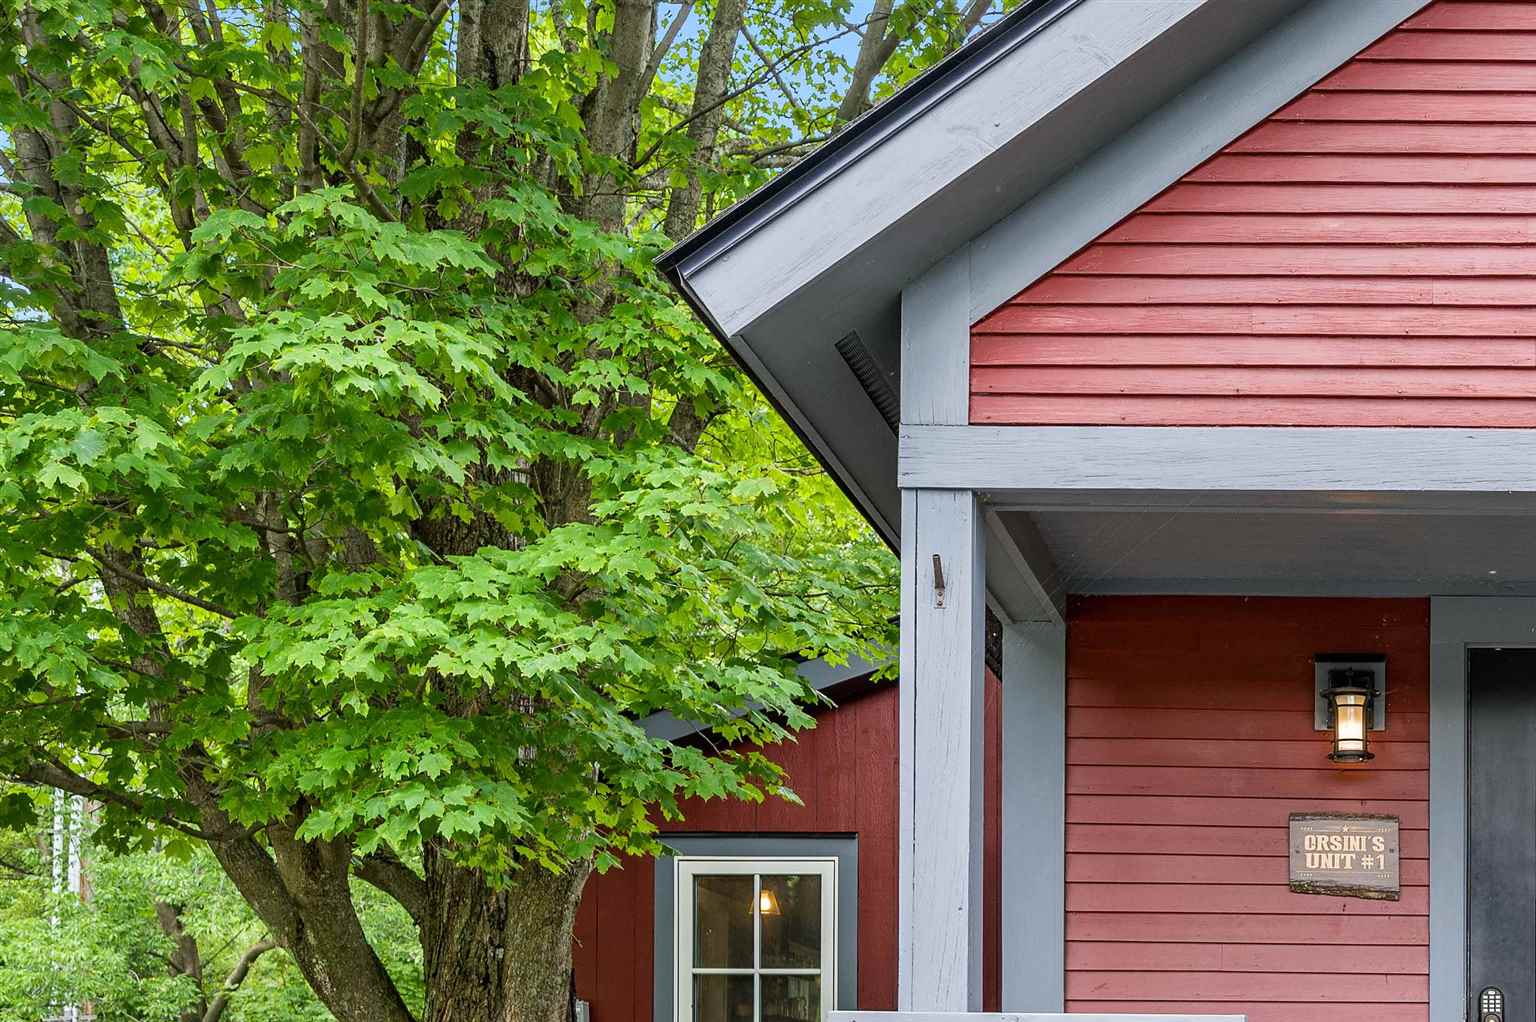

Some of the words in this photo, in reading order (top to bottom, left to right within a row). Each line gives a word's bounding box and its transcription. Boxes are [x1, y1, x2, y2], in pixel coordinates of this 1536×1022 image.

[1304, 834, 1385, 852] ORSINI'S
[1304, 853, 1356, 869] UNIT
[1361, 854, 1385, 870] #1
